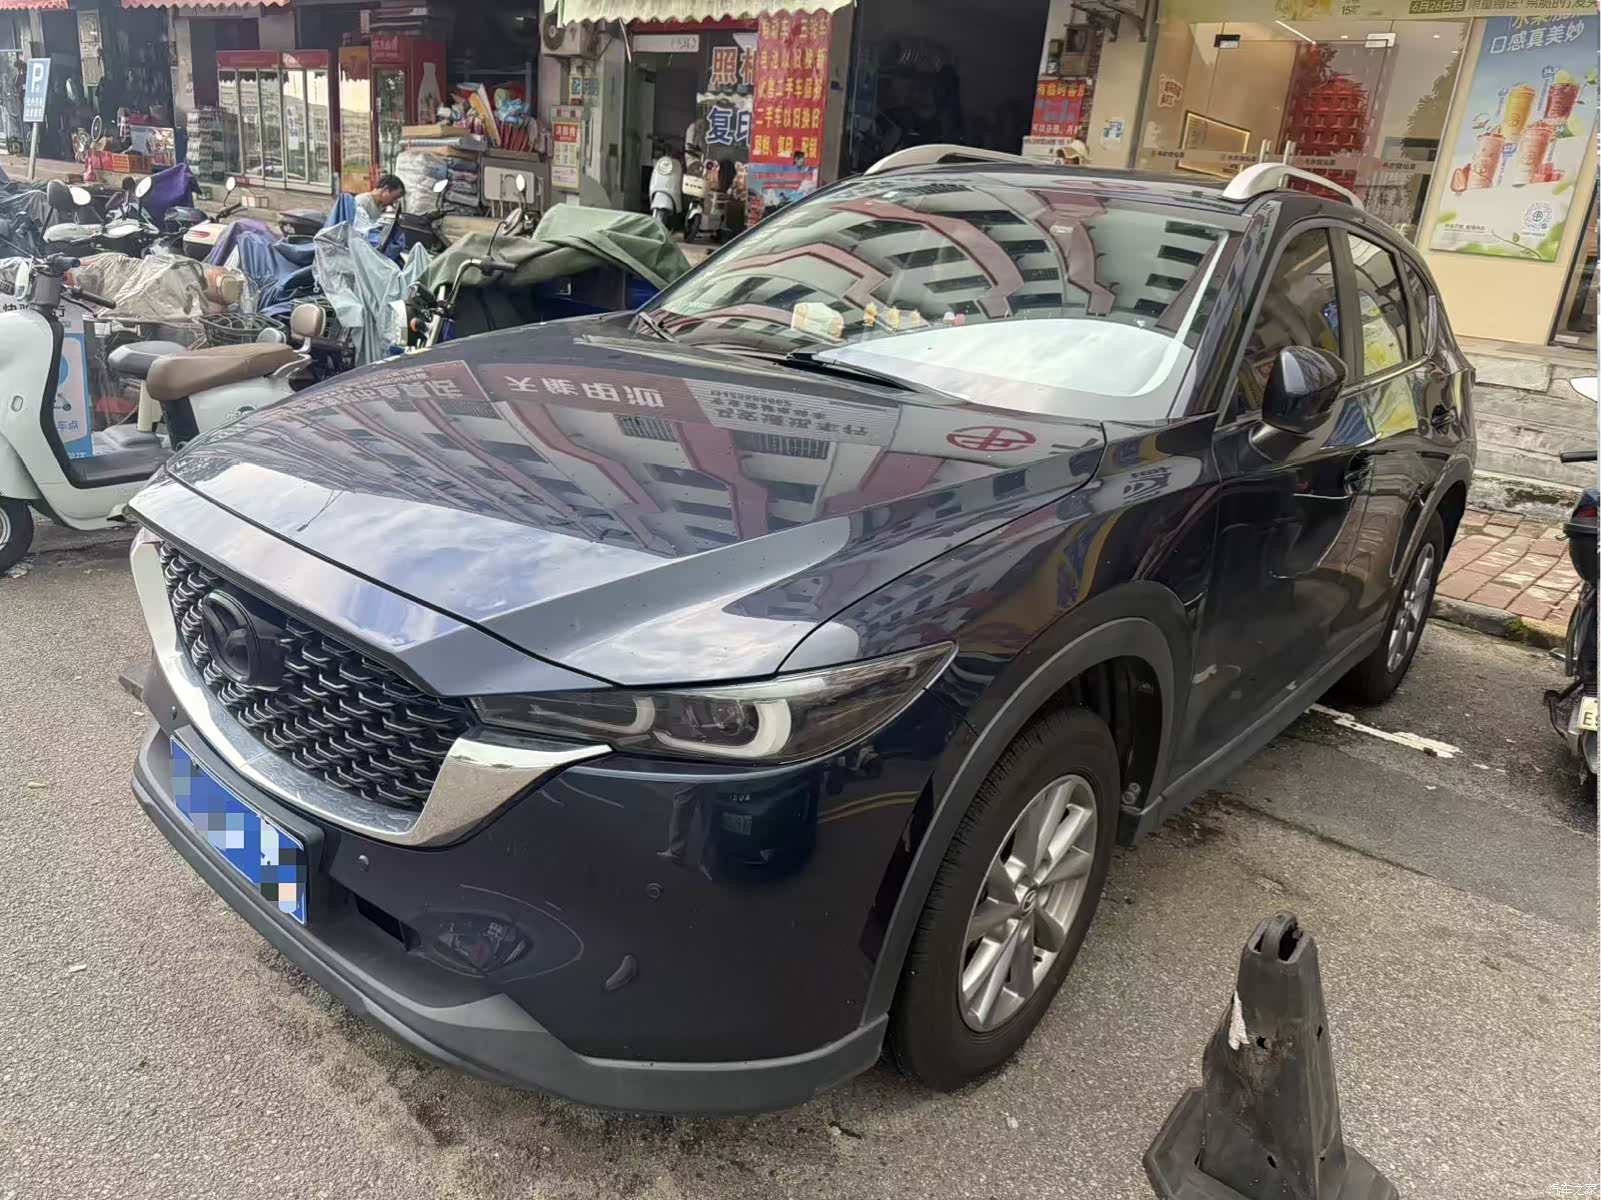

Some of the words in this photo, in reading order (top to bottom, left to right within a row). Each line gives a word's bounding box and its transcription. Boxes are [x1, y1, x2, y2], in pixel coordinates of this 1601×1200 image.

[1490, 21, 1585, 54] 口感真美妙
[31, 62, 44, 93] P
